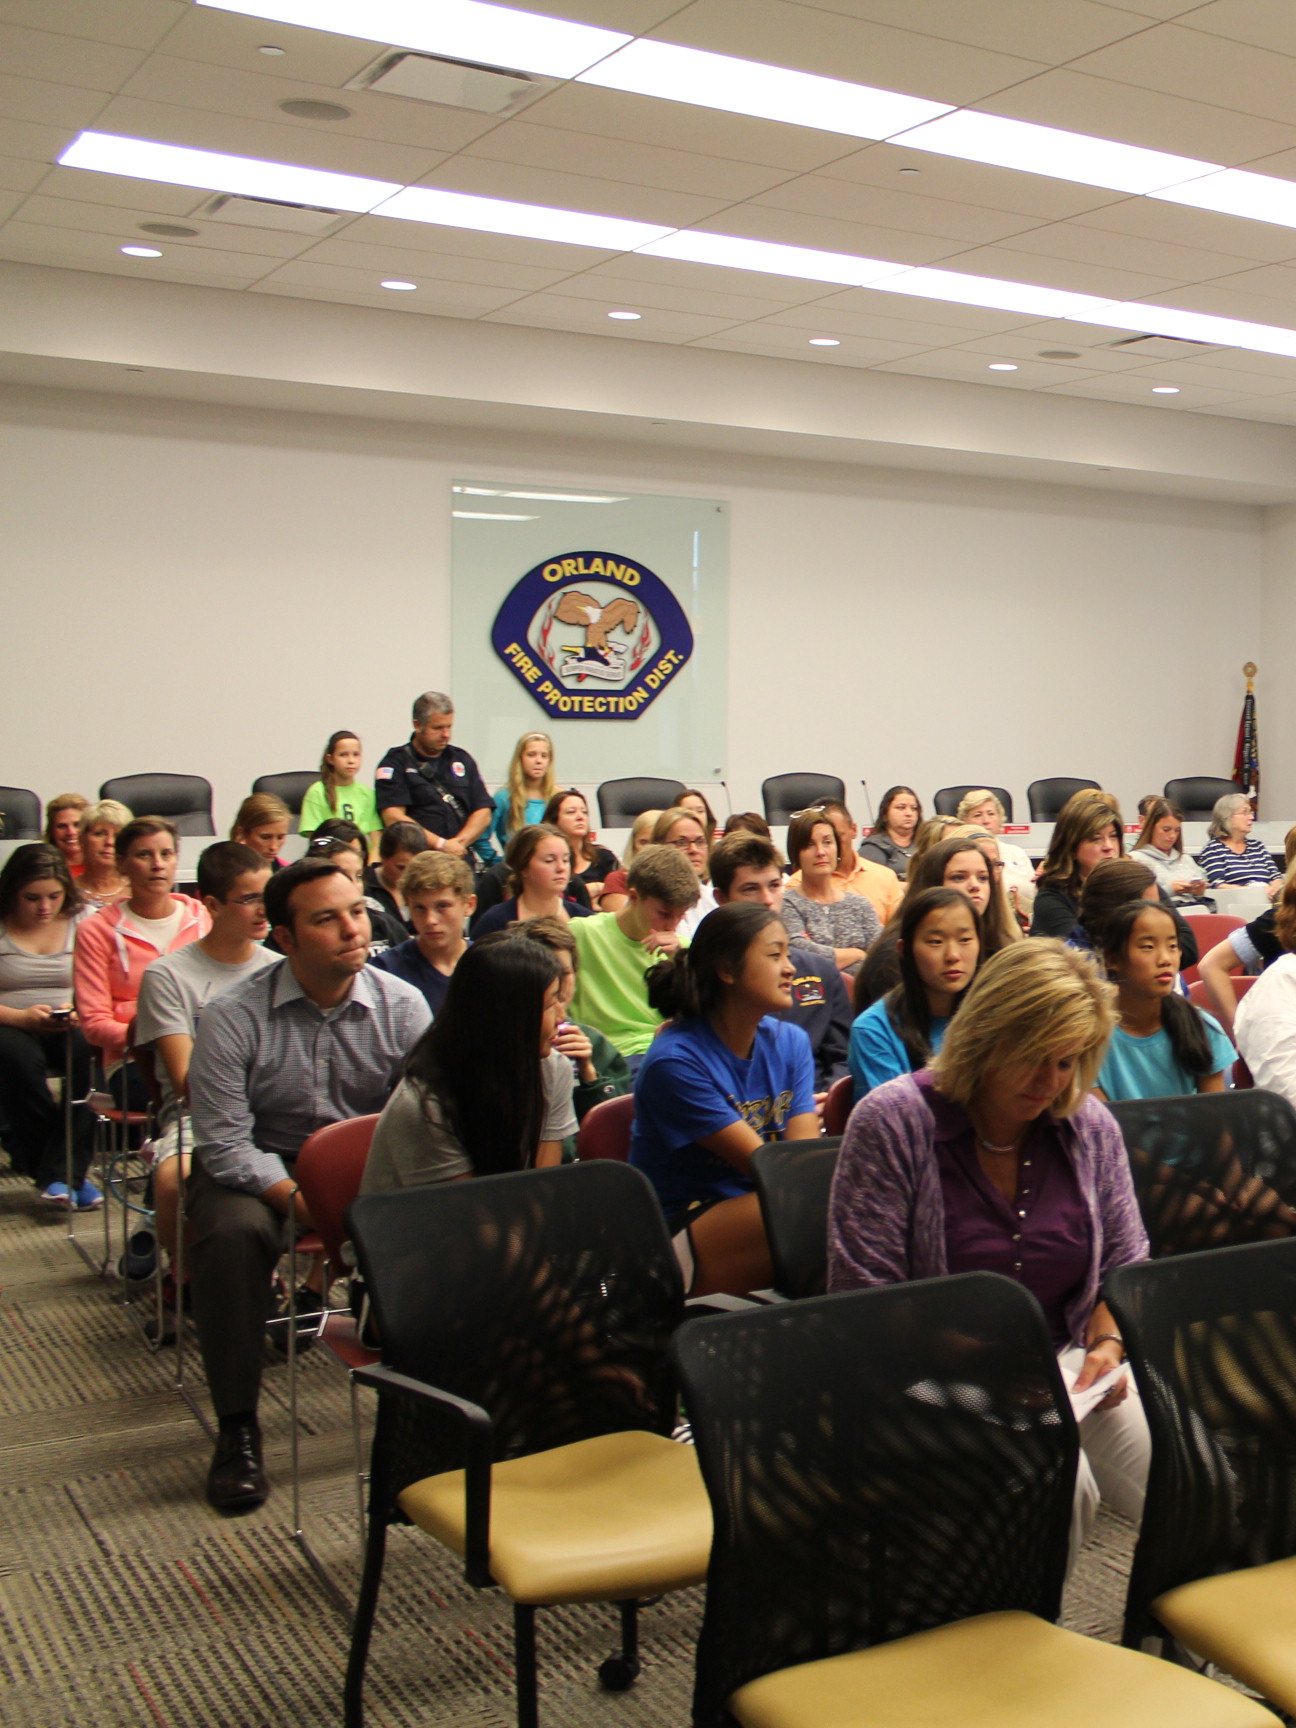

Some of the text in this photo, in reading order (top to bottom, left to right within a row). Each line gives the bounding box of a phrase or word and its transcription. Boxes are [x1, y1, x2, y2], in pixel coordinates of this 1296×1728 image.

[542, 557, 641, 586] ORLAND
[504, 642, 685, 713] FIRE PROTECTION DIST.
[342, 803, 354, 822] 6
